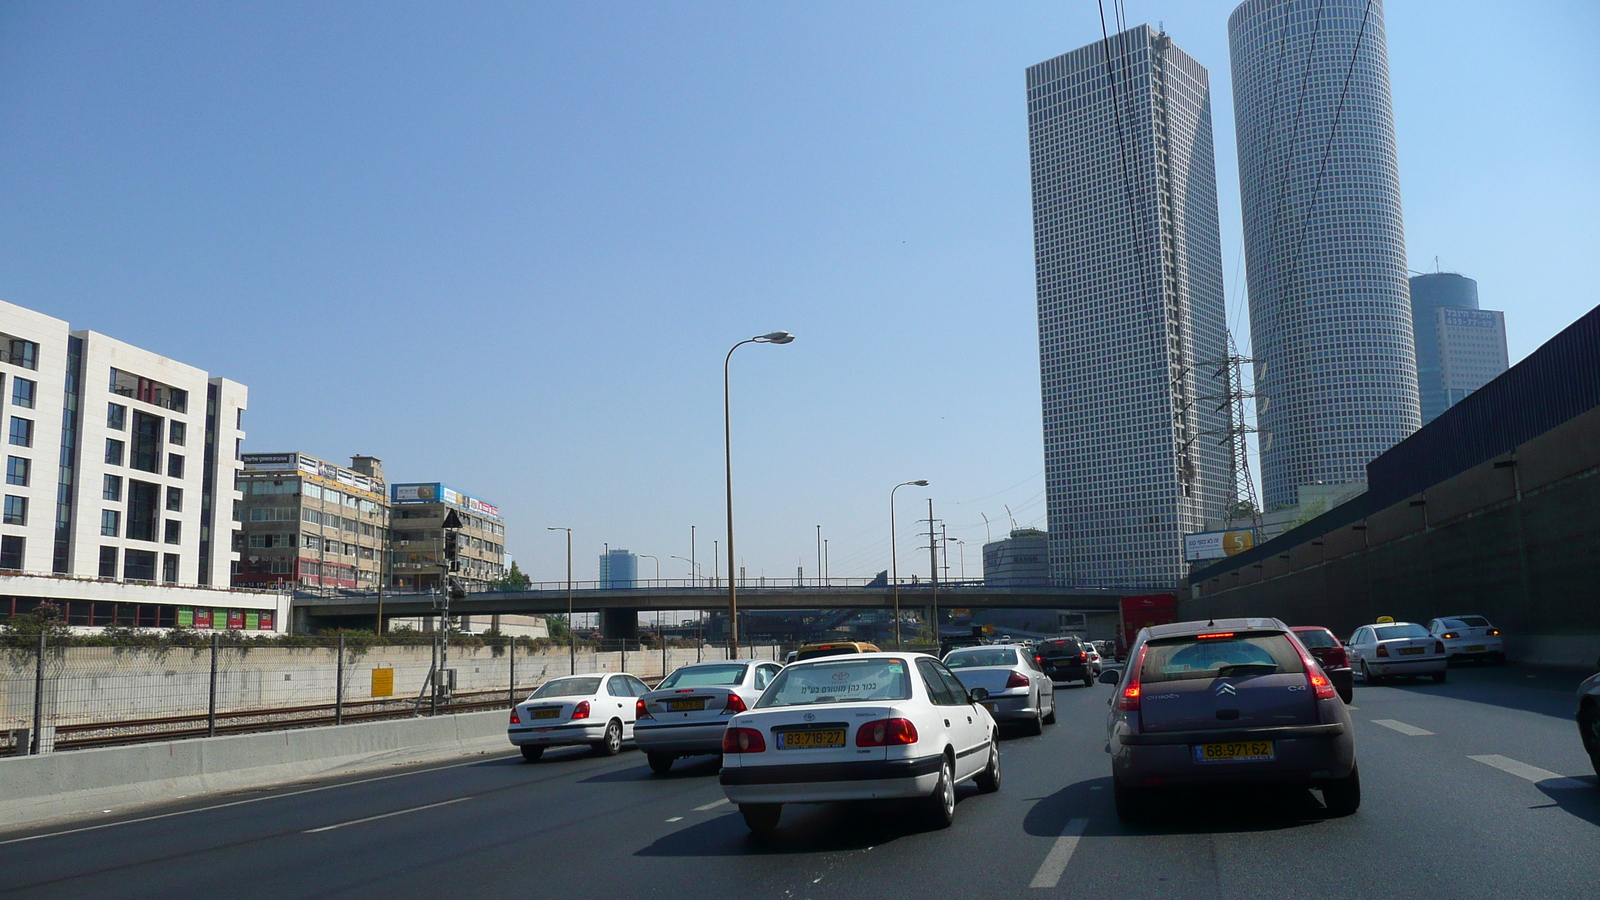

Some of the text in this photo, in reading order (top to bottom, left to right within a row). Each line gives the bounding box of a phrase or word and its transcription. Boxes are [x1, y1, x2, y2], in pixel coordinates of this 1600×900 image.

[1234, 536, 1244, 550] 5
[822, 685, 846, 693] מוטורס
[848, 684, 860, 693] כהן
[862, 682, 876, 690] בכור
